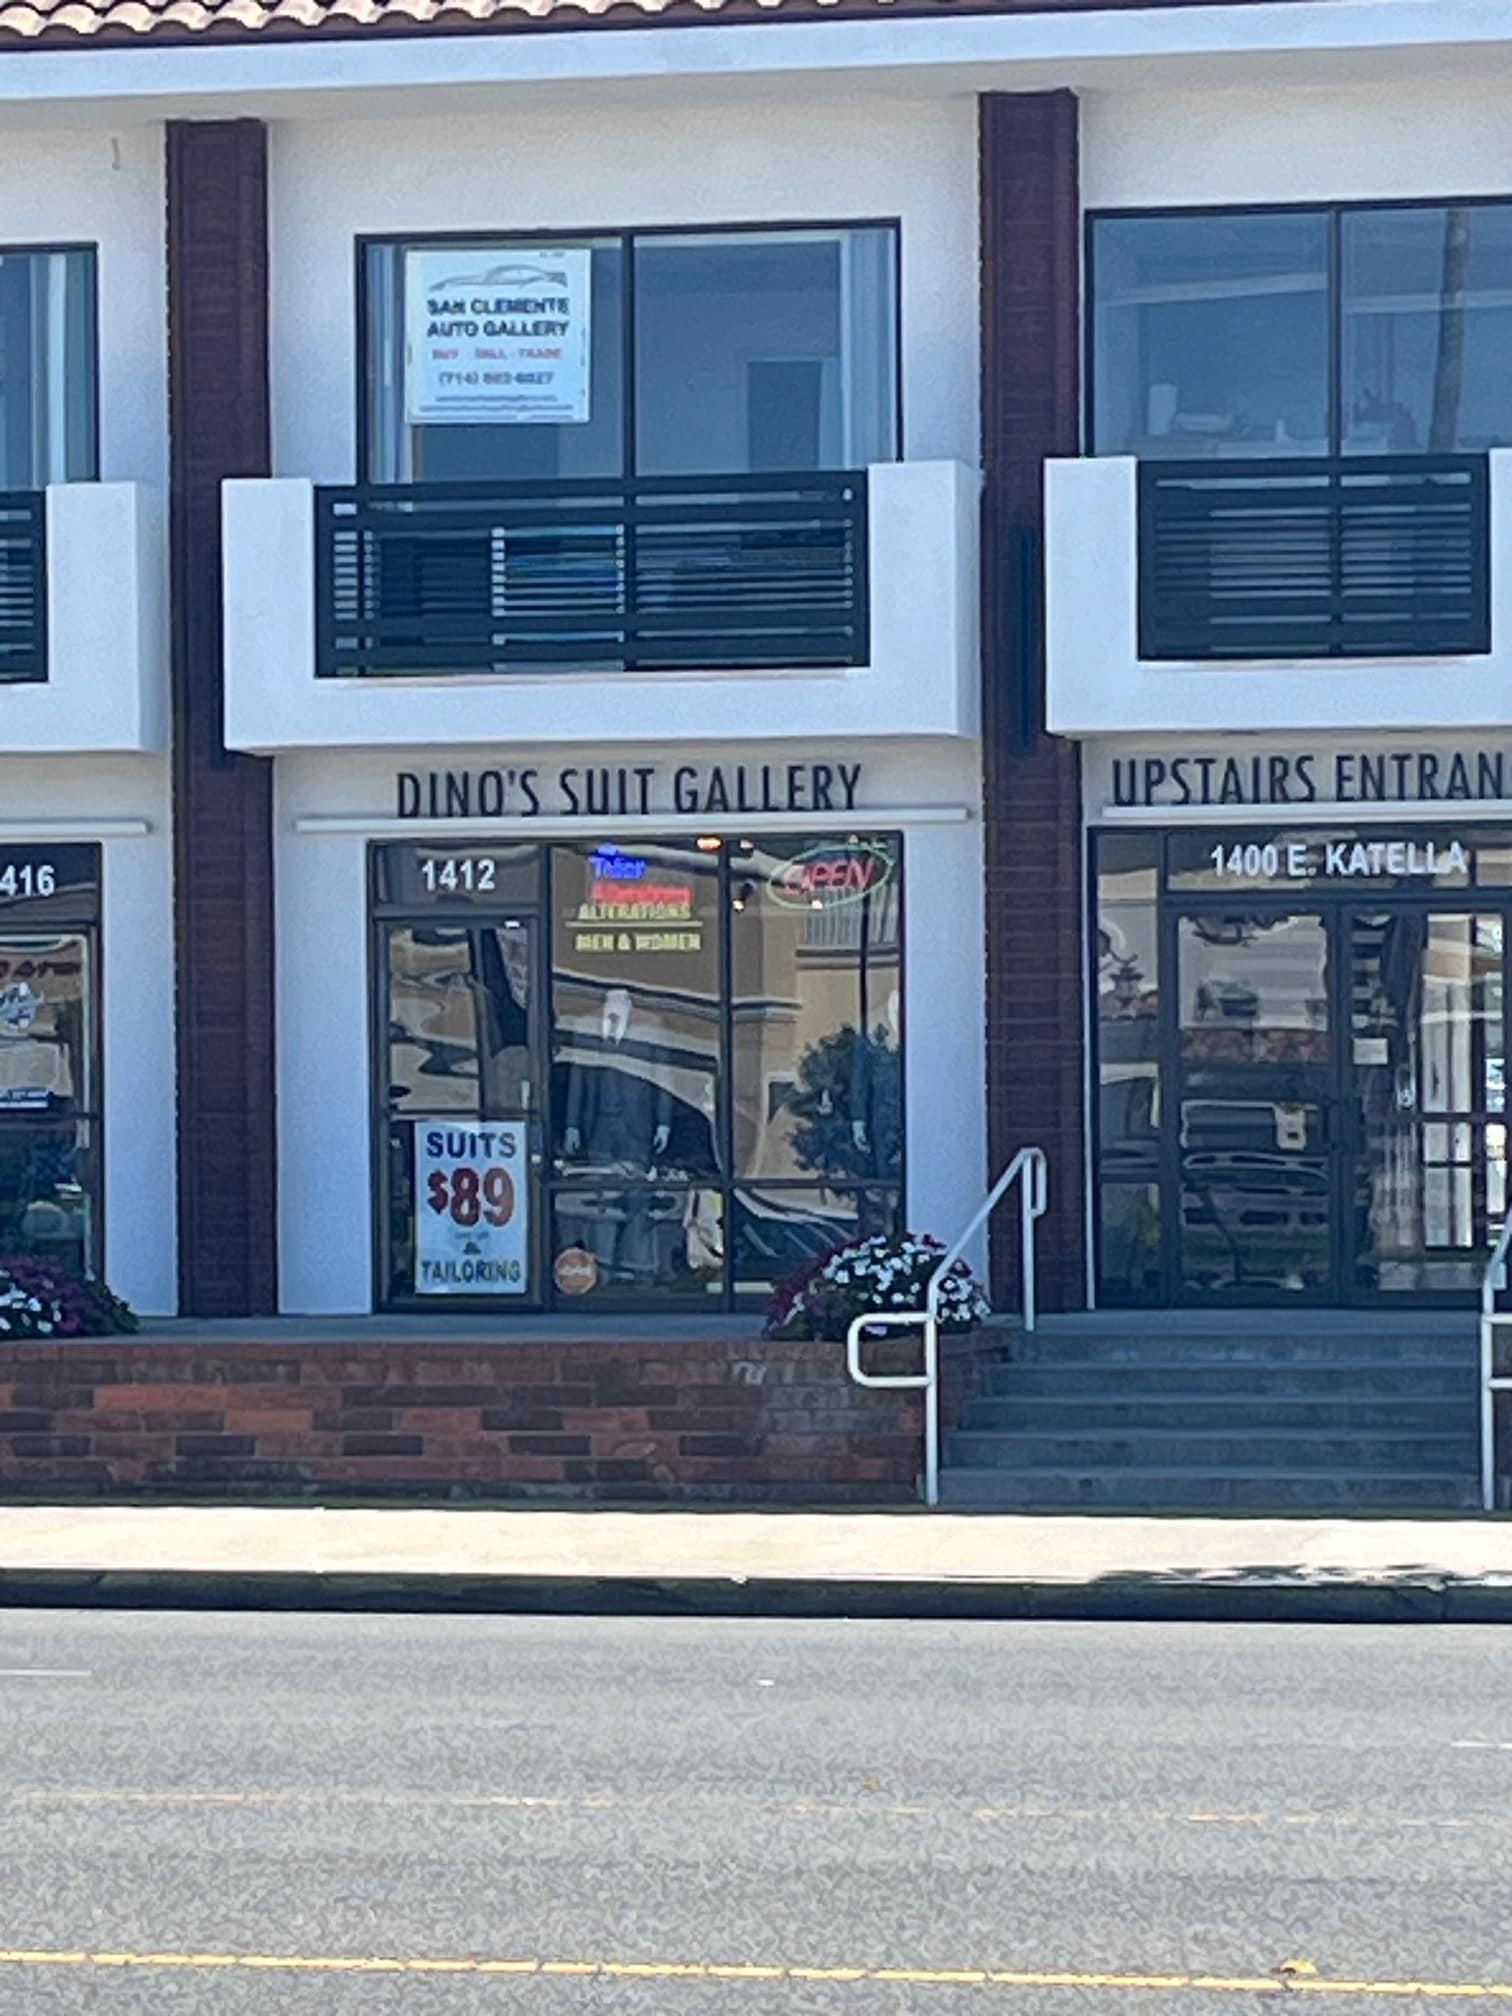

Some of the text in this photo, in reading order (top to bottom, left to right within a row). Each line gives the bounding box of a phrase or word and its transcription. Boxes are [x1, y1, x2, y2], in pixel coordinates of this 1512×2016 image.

[427, 298, 569, 315] SAN CLEMENTE
[427, 320, 568, 336] AUTO GALLERY
[397, 763, 862, 818] DINO'S SUIT GALLERY
[1112, 756, 1316, 806] UPSTAIRS
[1210, 841, 1468, 876] 1400 E. KATELLA
[421, 859, 496, 892] 1412
[578, 902, 692, 920] ALTERATIONS
[426, 1132, 516, 1159] SUITS
[426, 1167, 515, 1228] $89
[421, 1259, 521, 1283] TAILORING
